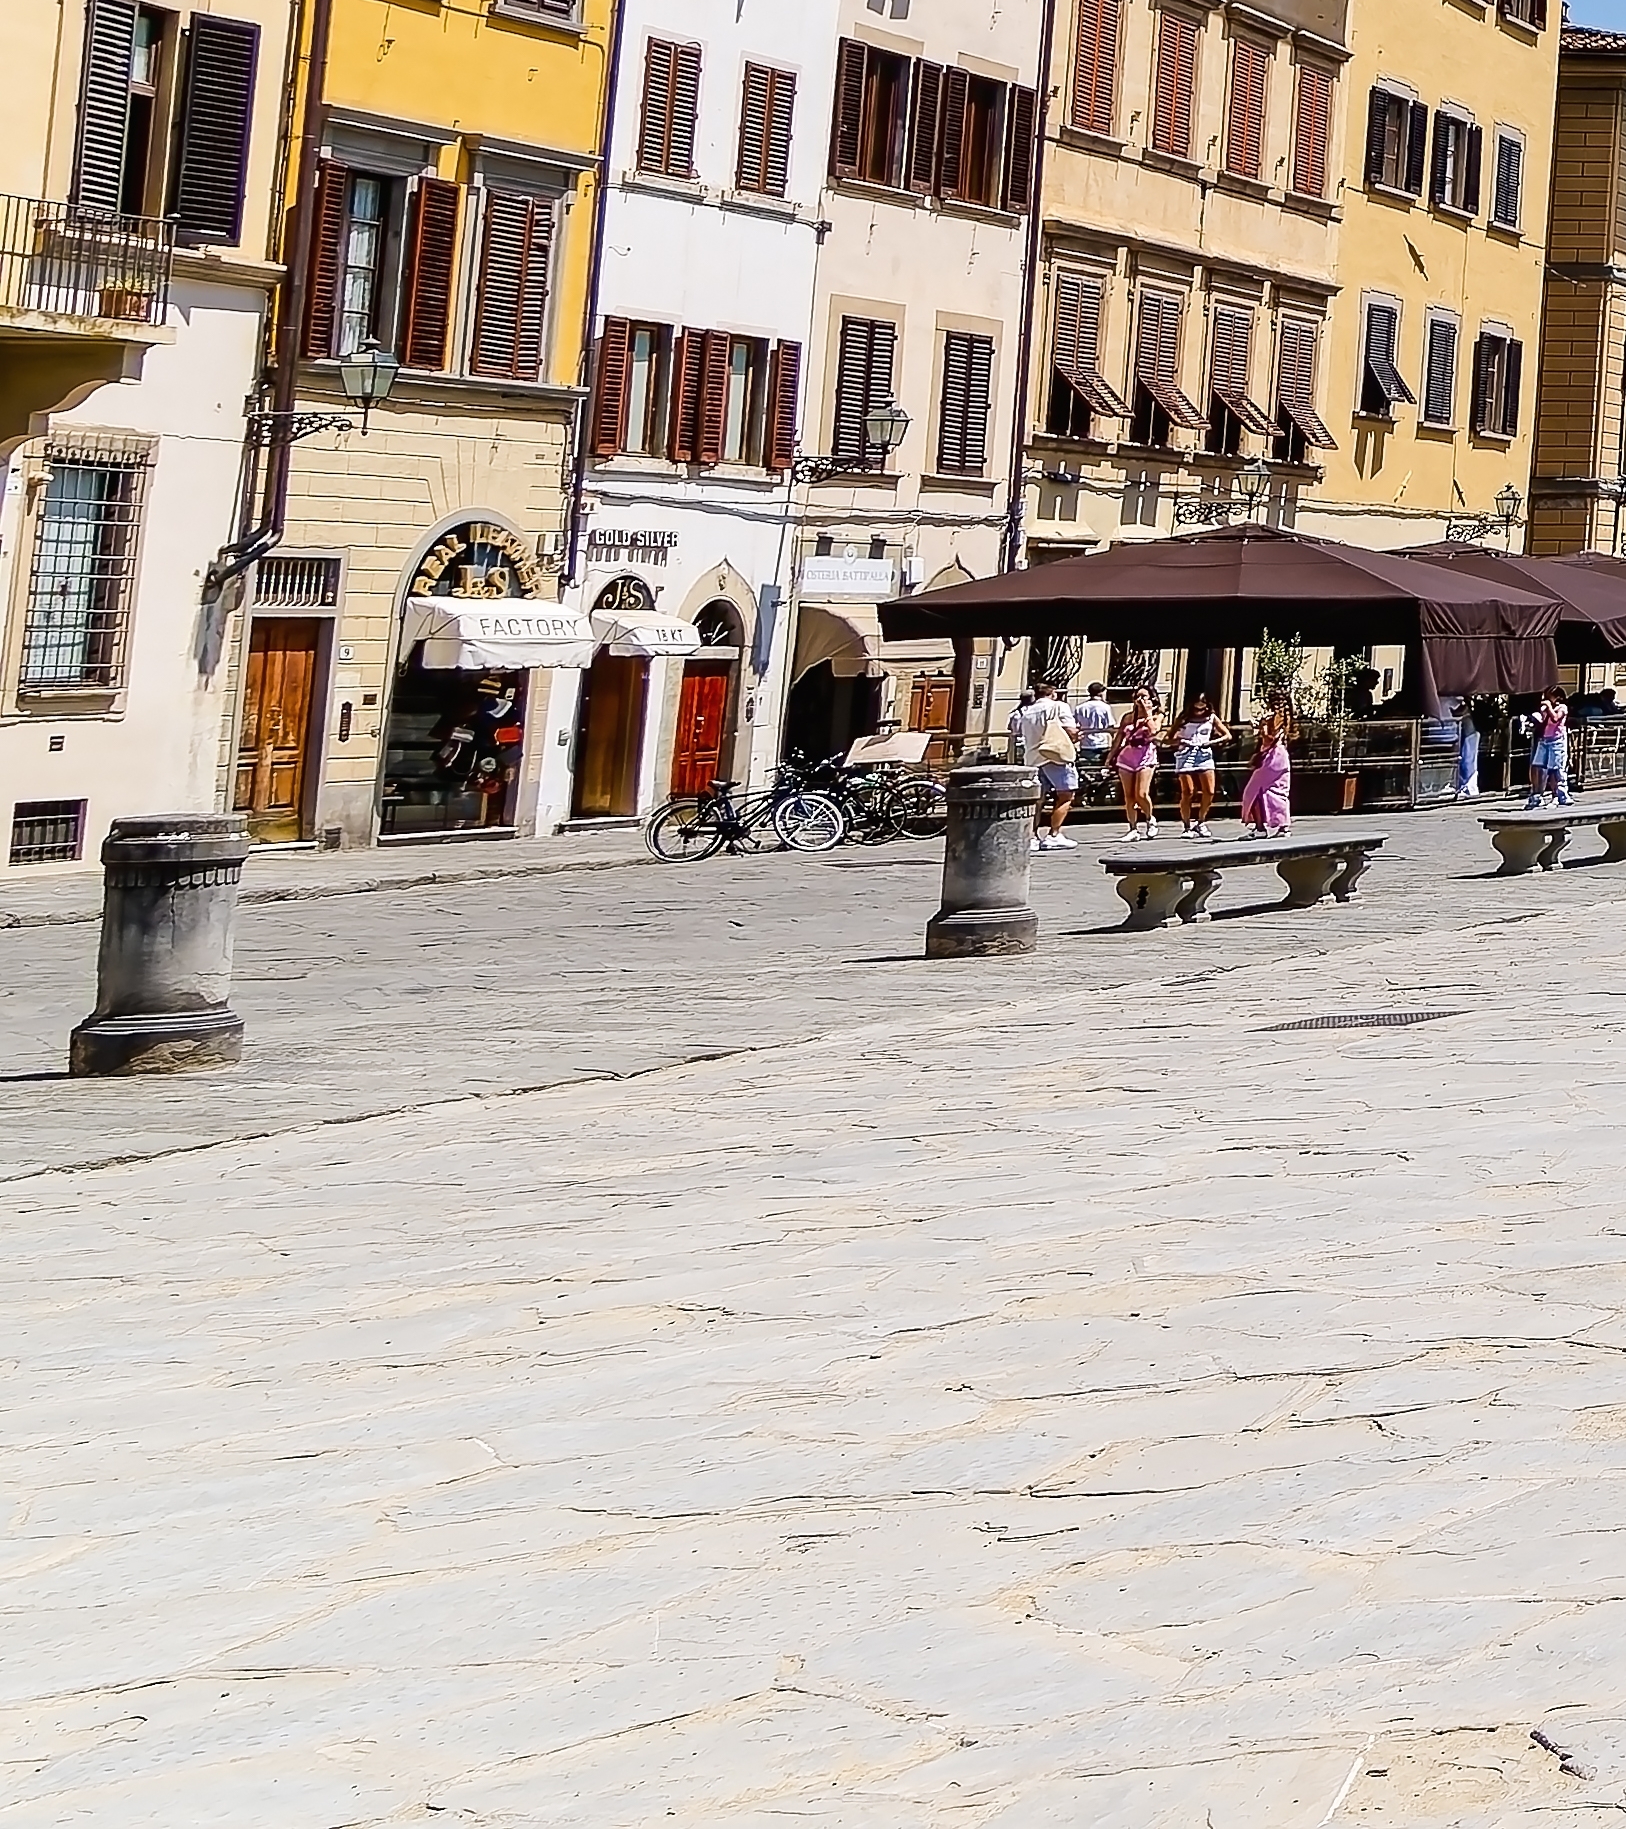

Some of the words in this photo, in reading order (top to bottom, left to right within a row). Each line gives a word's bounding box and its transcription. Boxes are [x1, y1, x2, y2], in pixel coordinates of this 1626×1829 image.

[595, 529, 631, 546] GOLD
[636, 530, 680, 548] SILVER
[411, 533, 467, 597] REAL
[469, 523, 541, 599] LEATHER
[806, 569, 840, 581] OSTERIA
[602, 579, 644, 610] J&S
[479, 617, 579, 637] FACTORY
[670, 628, 684, 643] KT
